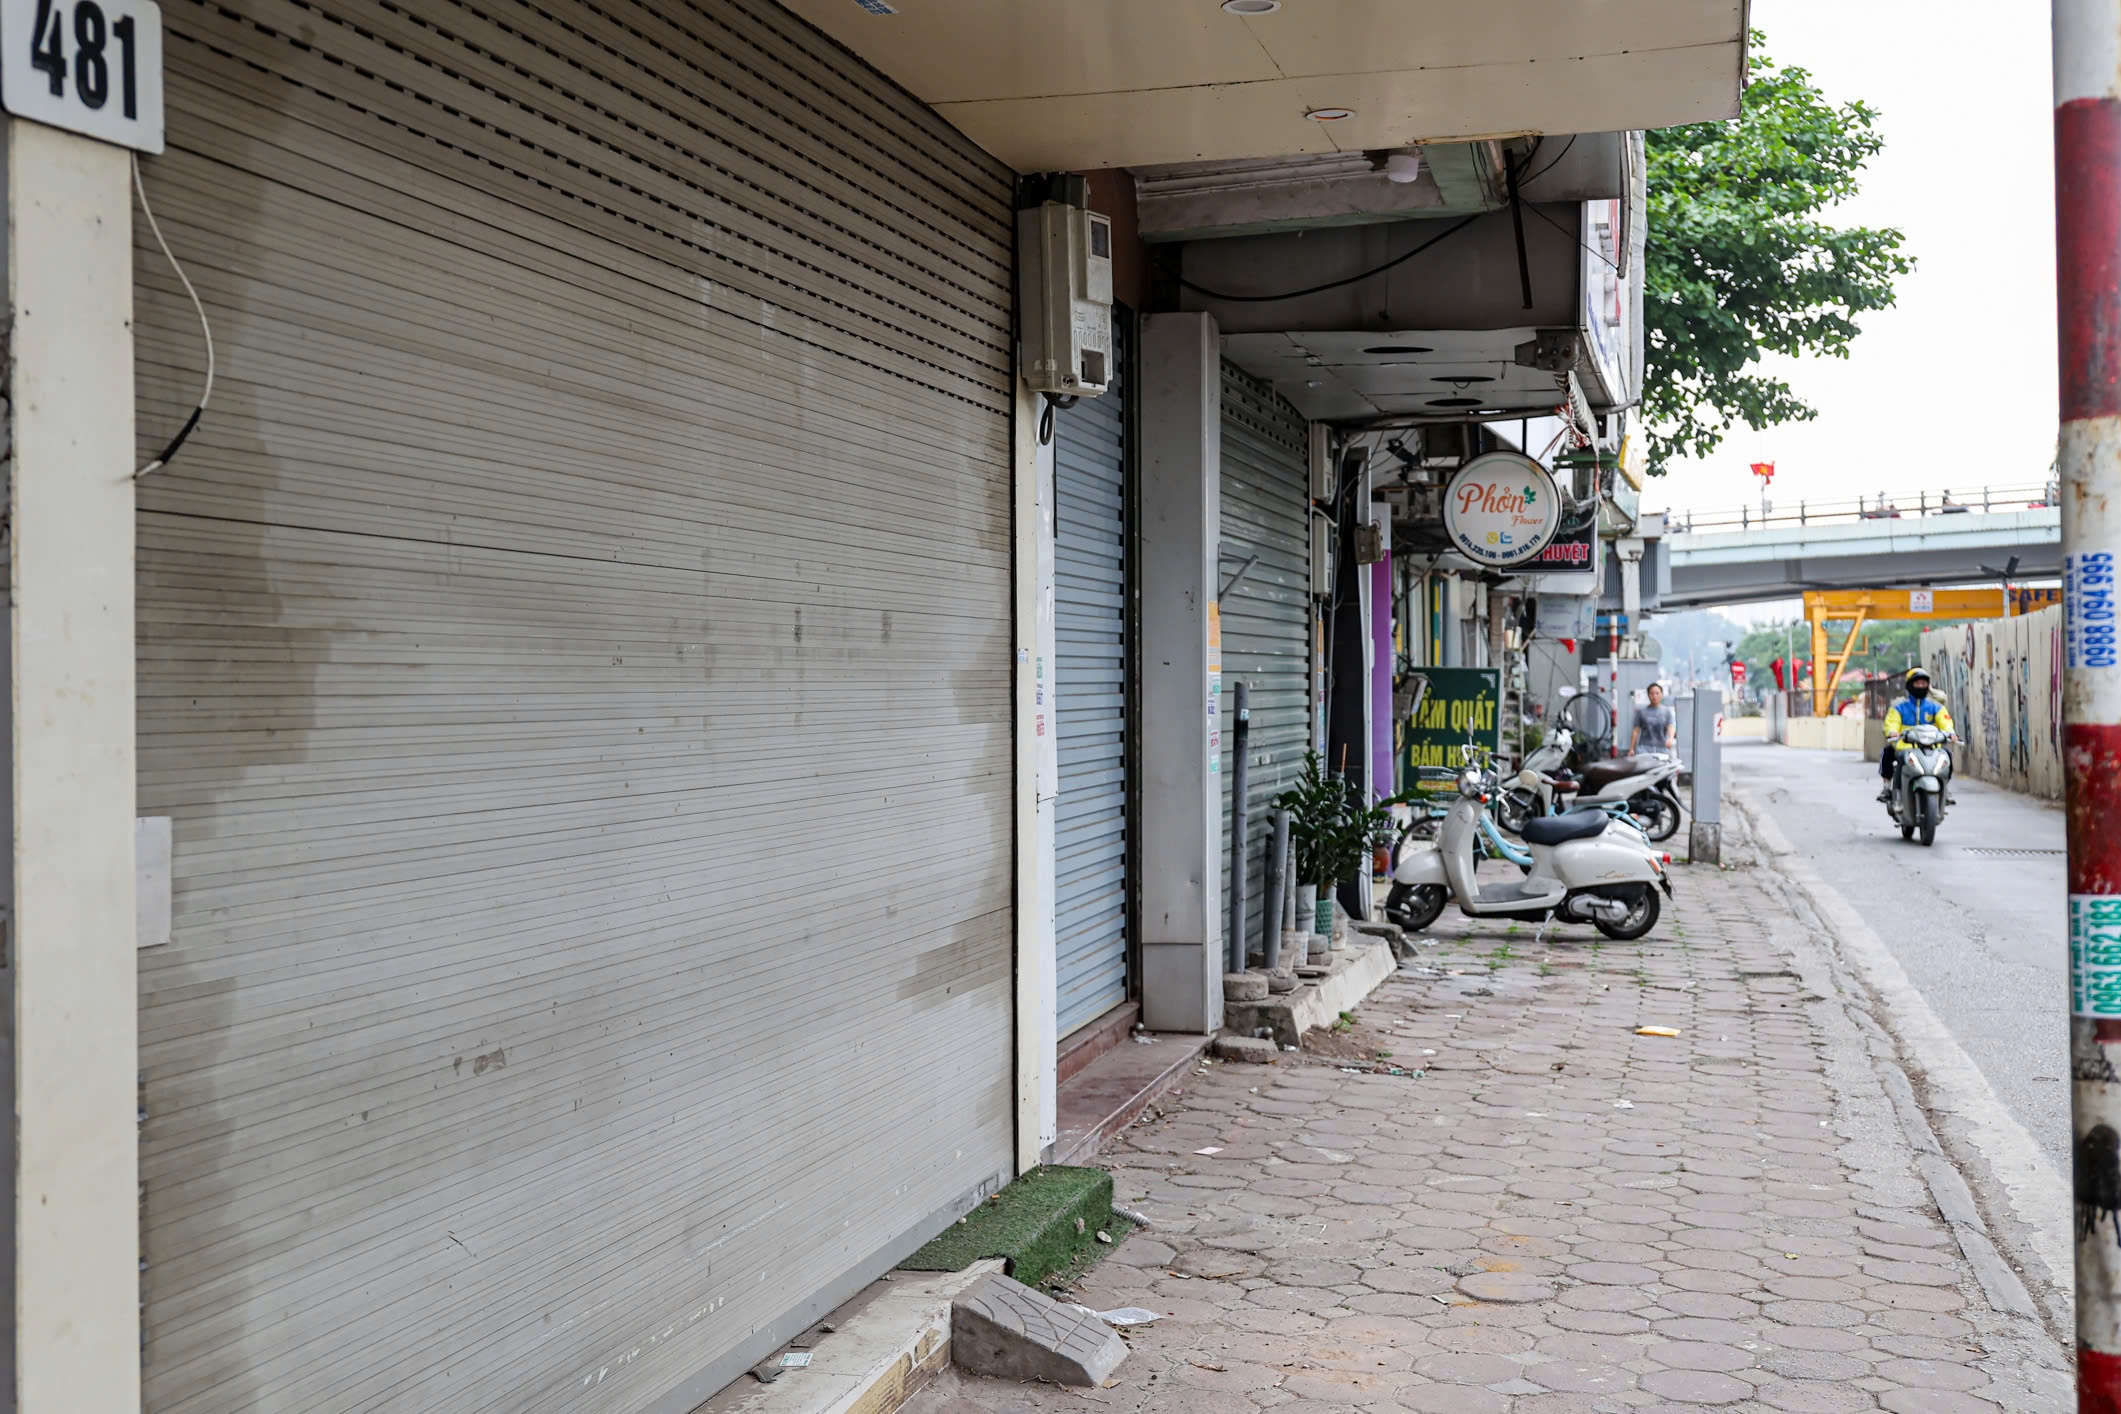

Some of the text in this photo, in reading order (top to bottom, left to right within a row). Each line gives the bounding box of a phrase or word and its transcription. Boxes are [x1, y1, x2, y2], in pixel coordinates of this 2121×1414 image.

[32, 0, 137, 121] 481
[1457, 483, 1528, 514] Phởn
[2009, 589, 2056, 602] SAFE
[2082, 553, 2116, 667] 0988.094.995
[1451, 689, 1495, 733] QUẤT
[1411, 737, 1443, 768] BẤM
